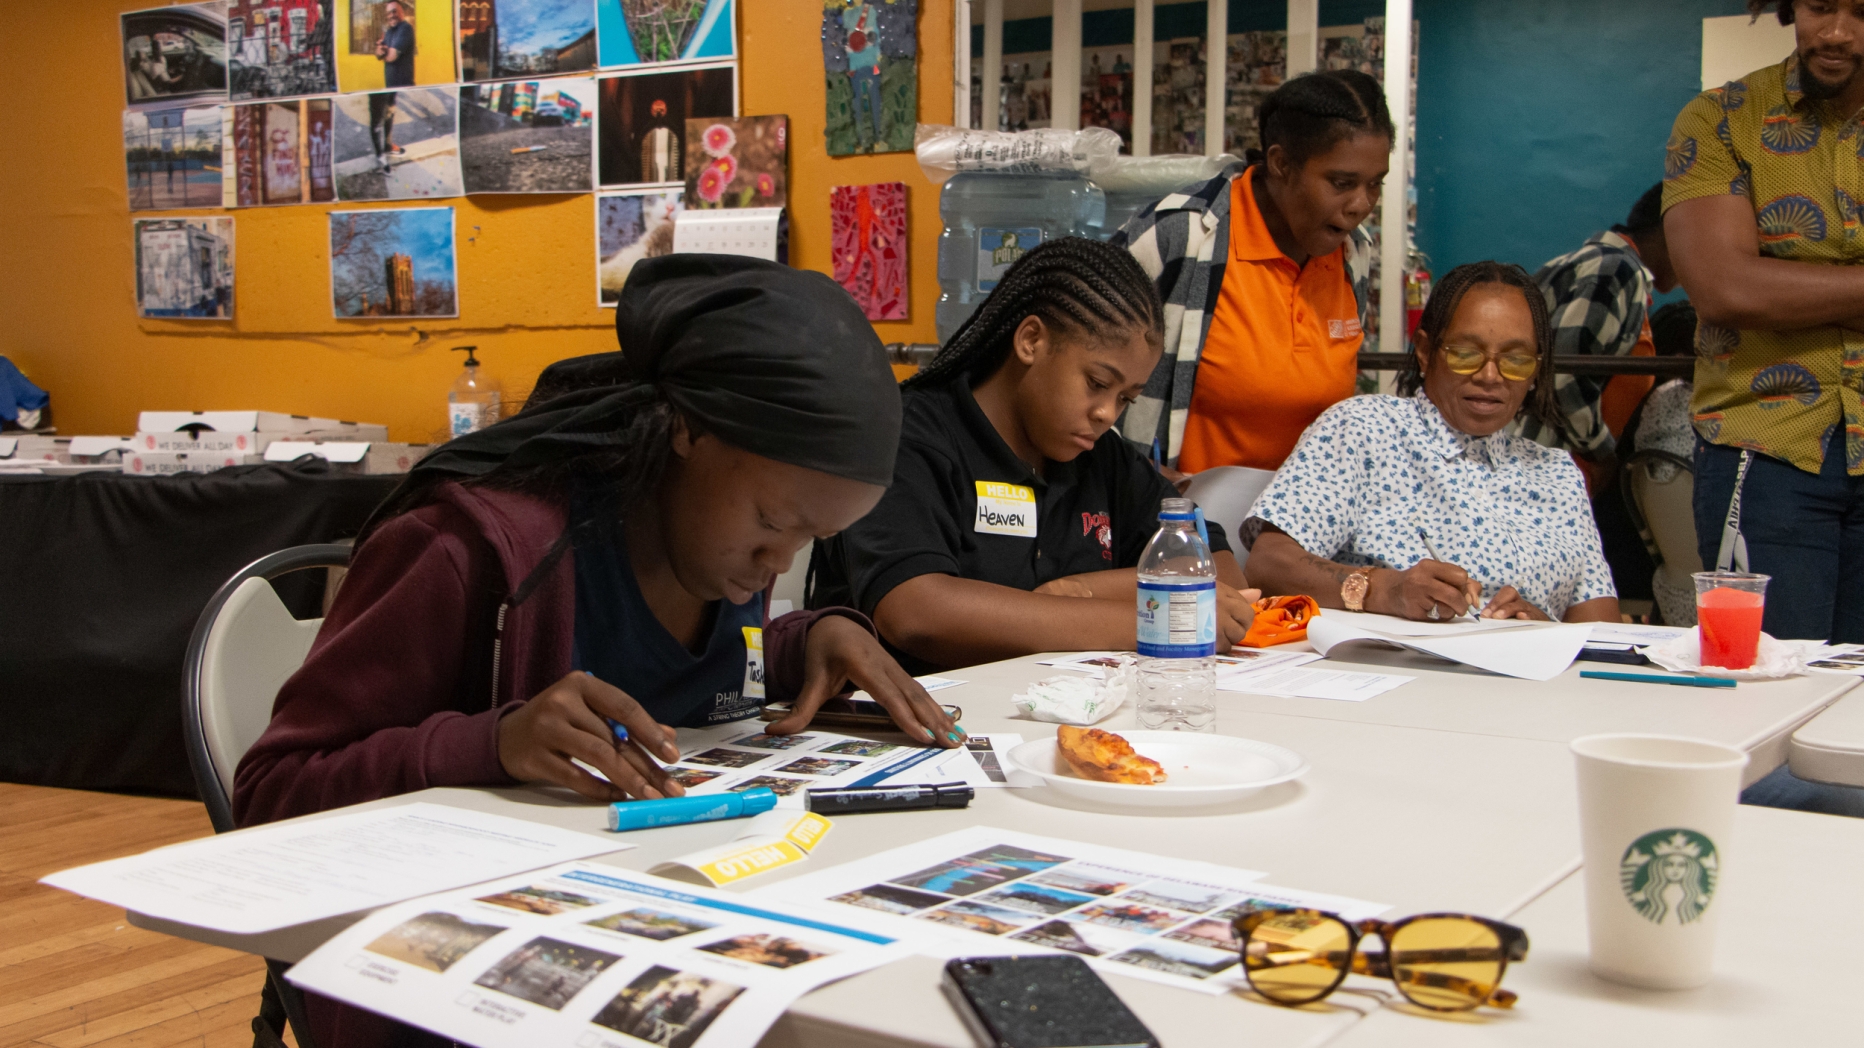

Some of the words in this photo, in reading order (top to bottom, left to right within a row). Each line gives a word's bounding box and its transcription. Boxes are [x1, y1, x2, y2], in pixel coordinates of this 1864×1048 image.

[158, 442, 169, 451] WE
[172, 442, 200, 451] DELIVER
[204, 442, 217, 451] ALL
[219, 442, 233, 451] DAY
[986, 484, 1028, 500] HELLO
[791, 816, 825, 844] HELLO
[714, 844, 788, 878] HELLO
